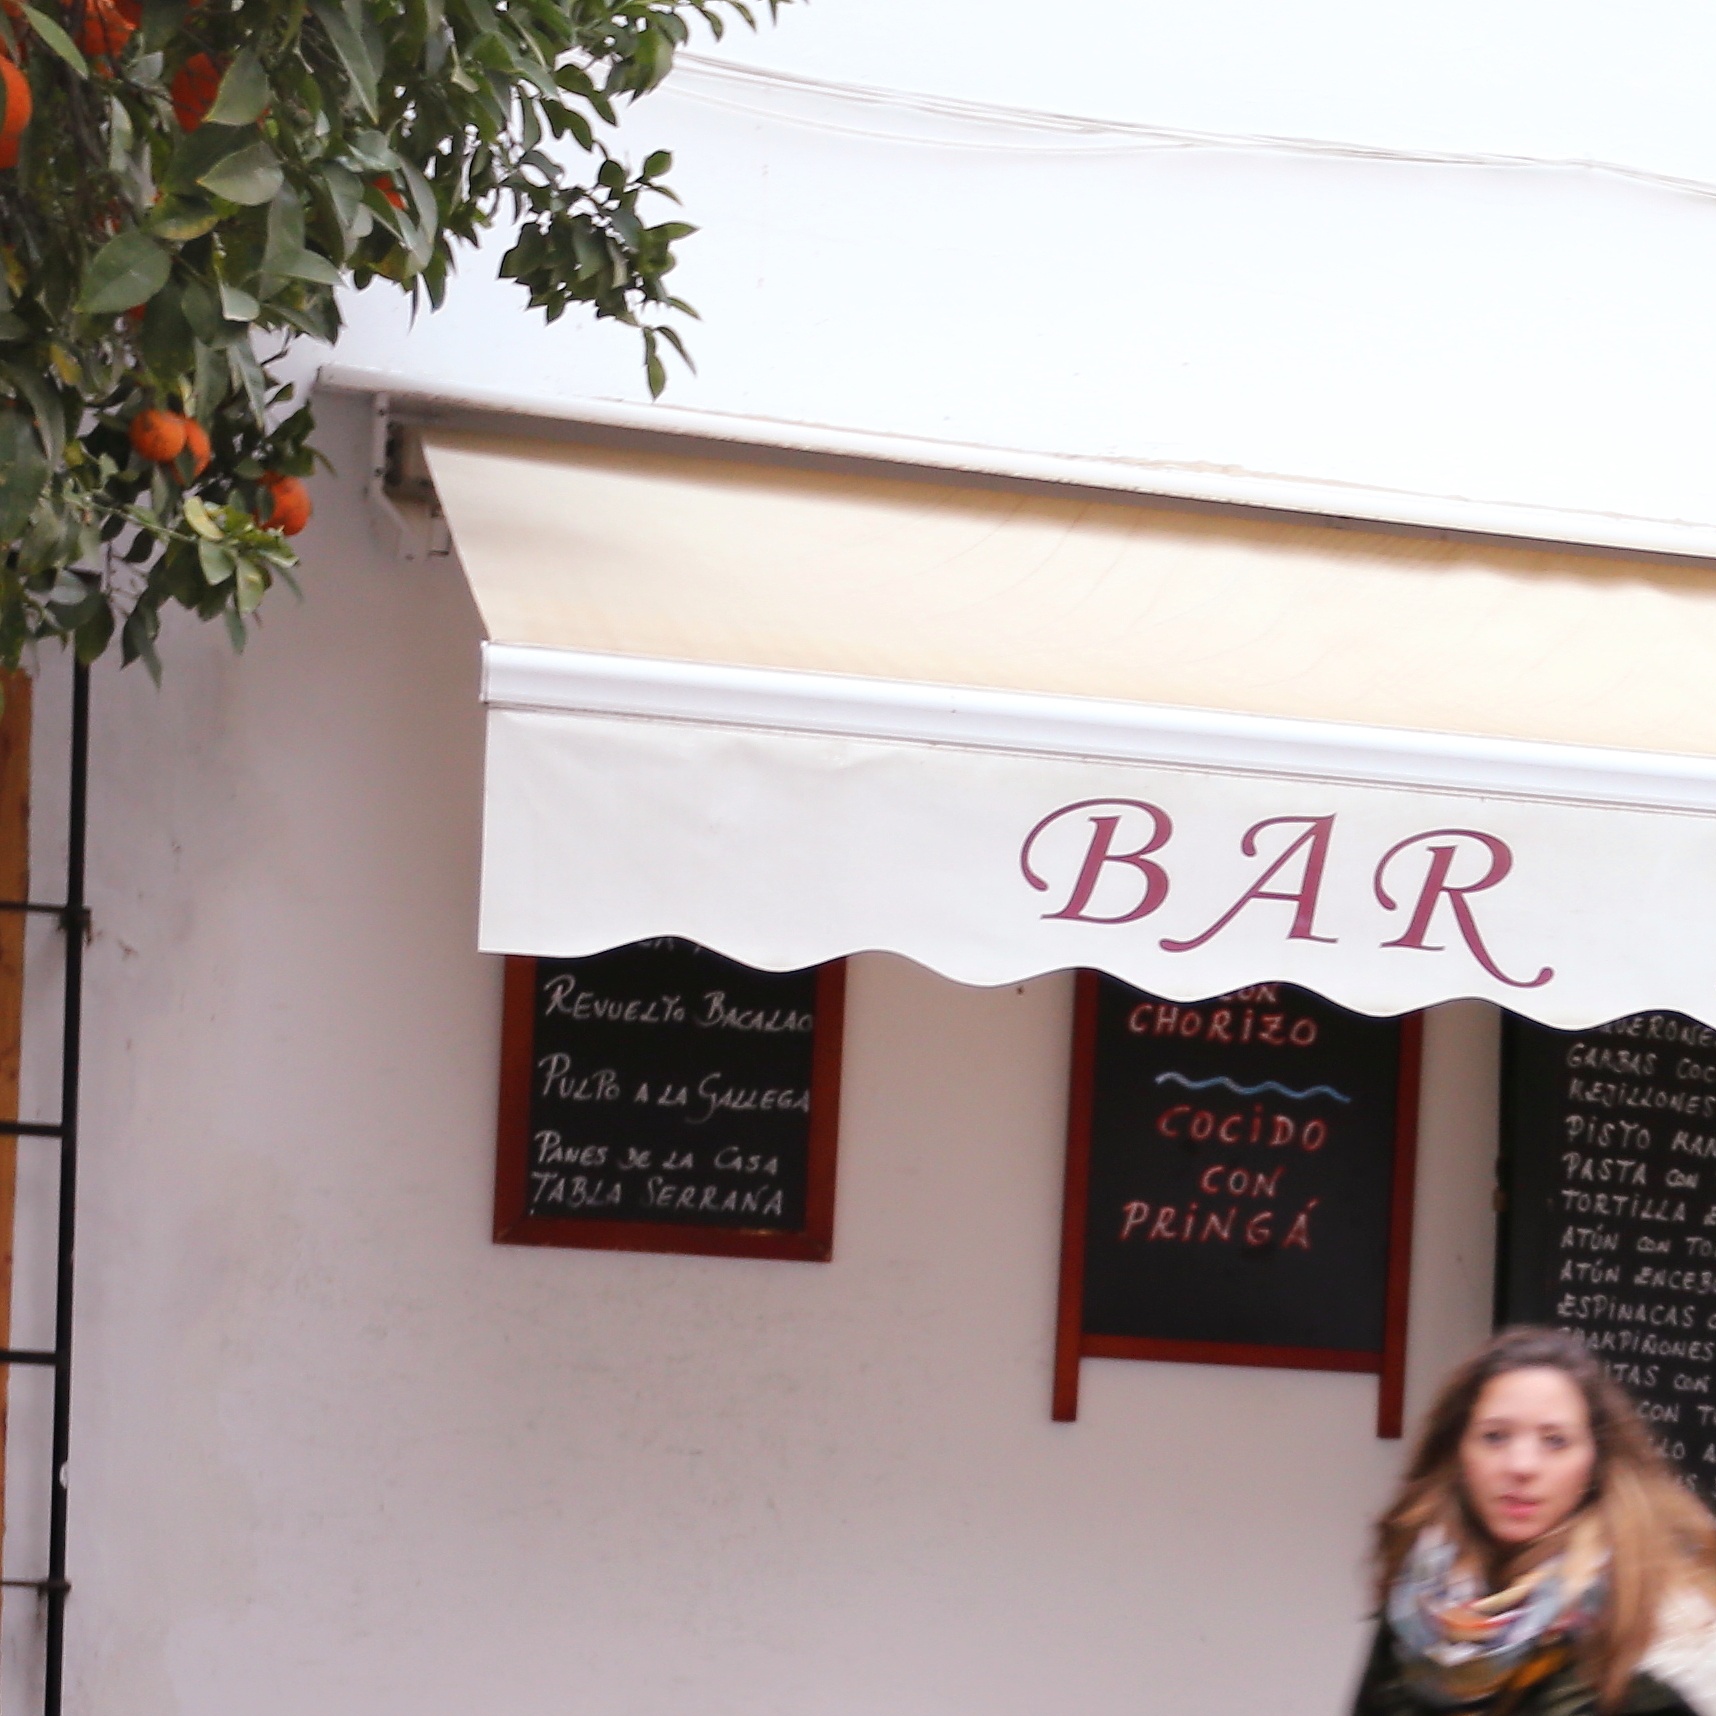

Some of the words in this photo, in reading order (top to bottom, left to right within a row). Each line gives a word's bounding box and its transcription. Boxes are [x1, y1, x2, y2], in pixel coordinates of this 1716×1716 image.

[1020, 797, 1555, 988] BAR
[543, 974, 686, 1024] REVUELTO
[694, 990, 813, 1032] BACALAO
[538, 1052, 621, 1102] PULPO
[634, 1082, 650, 1102] A
[657, 1083, 687, 1107] LA
[685, 1071, 811, 1124] GALLEGA
[533, 1129, 608, 1166] PANES
[662, 1148, 694, 1171] LA
[714, 1146, 779, 1175] CASA
[1562, 1152, 1648, 1187] PASTA
[531, 1170, 623, 1206] TABLA
[646, 1176, 783, 1217] SERRANA
[1200, 1166, 1287, 1199] CON
[1561, 1188, 1687, 1224] TORTILLA
[1557, 1293, 1697, 1330] ESPINACAS
